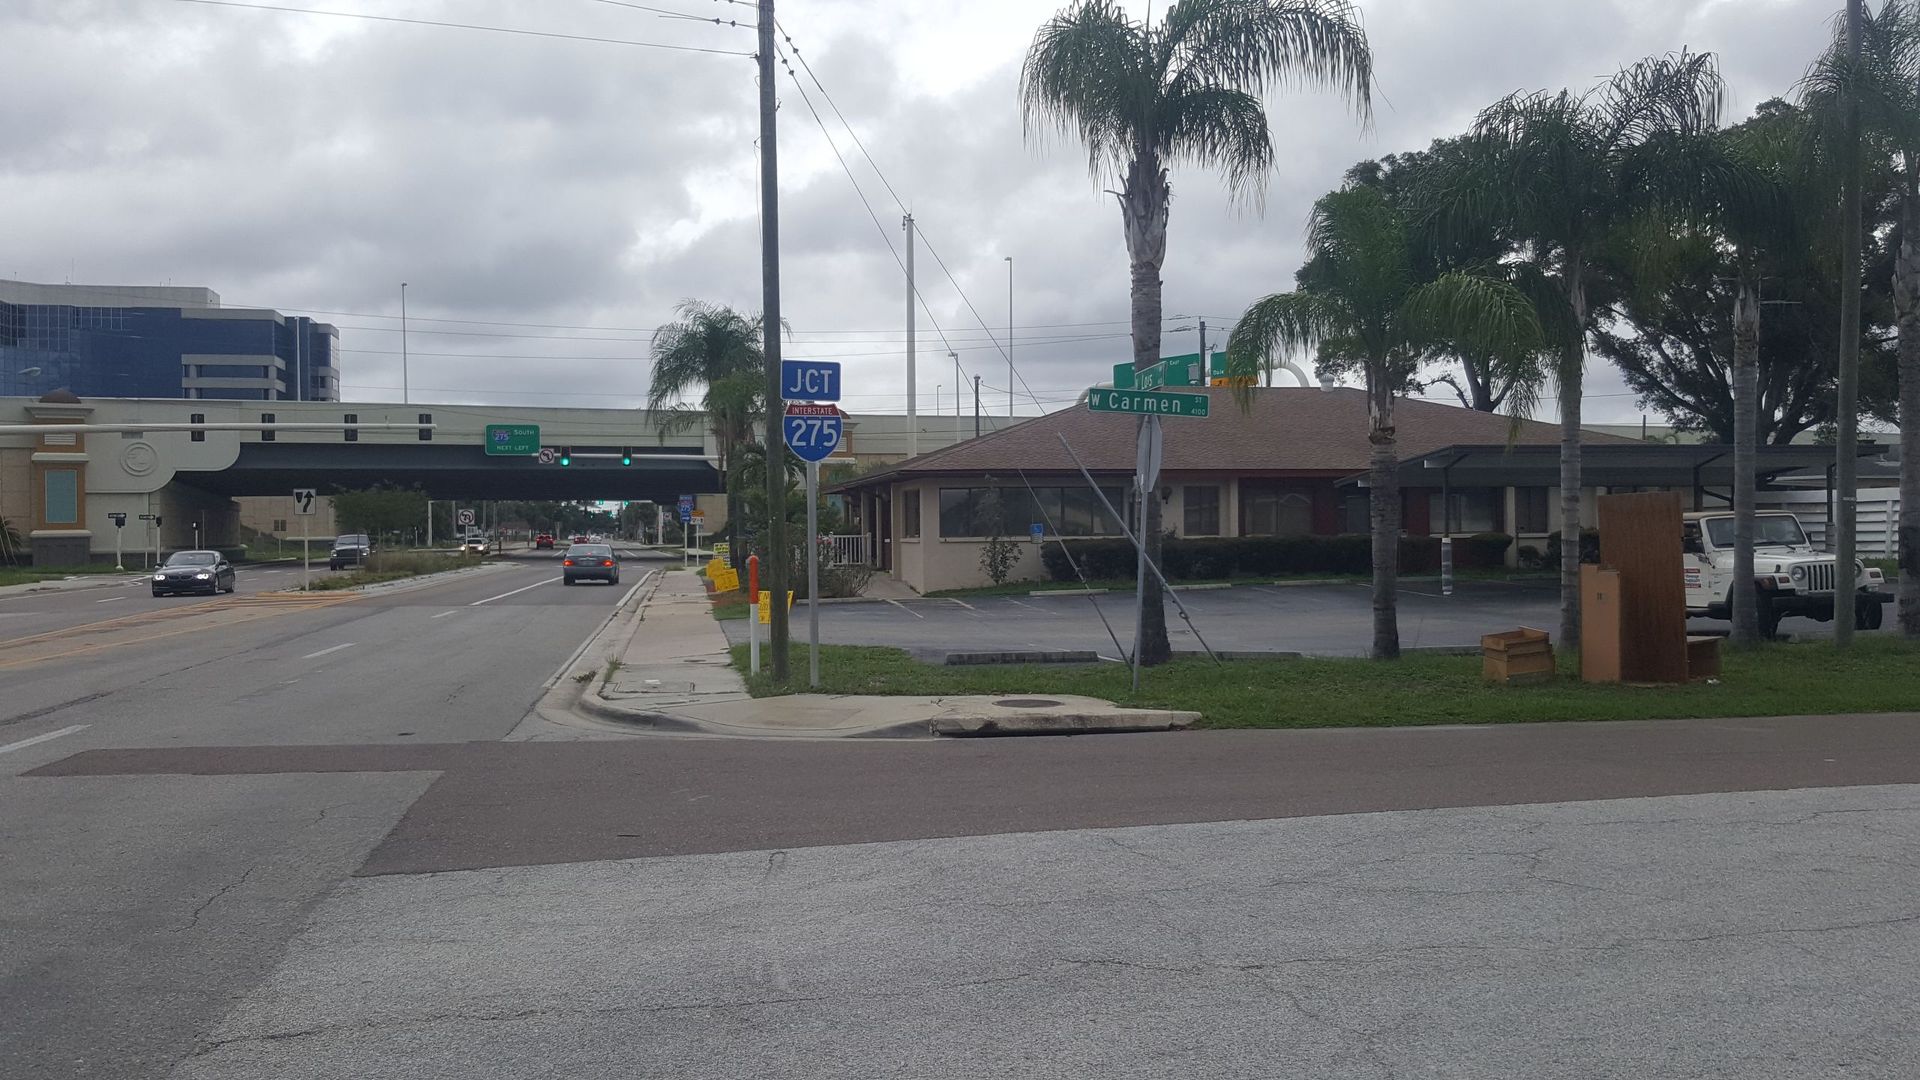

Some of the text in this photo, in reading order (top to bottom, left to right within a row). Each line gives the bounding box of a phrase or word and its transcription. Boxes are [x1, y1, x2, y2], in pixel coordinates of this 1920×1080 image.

[789, 368, 833, 394] JCT
[1091, 393, 1100, 407] W
[1109, 392, 1181, 412] Carmen
[792, 406, 833, 415] INTERSTATE
[1191, 407, 1206, 416] 4100
[495, 433, 509, 441] 275
[791, 419, 838, 447] 275
